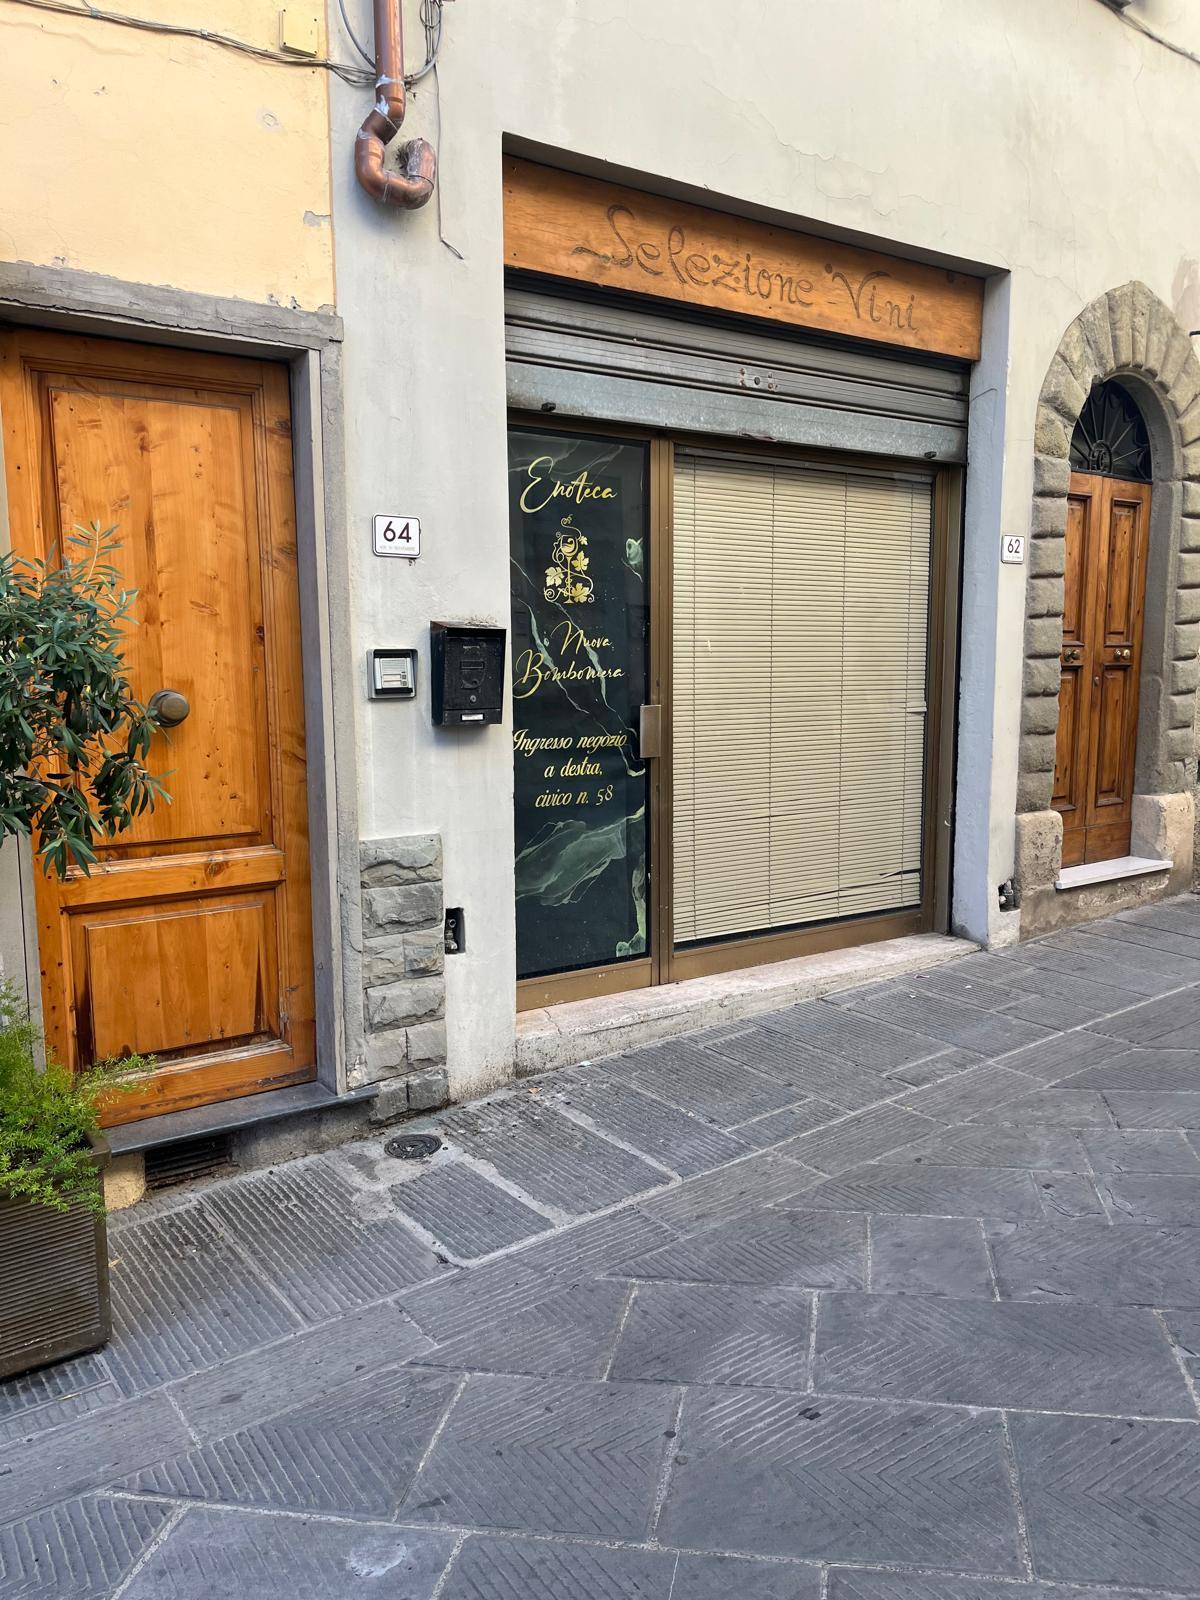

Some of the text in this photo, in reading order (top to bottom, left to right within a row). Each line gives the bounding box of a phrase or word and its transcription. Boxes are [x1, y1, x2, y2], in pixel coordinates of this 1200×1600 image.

[572, 204, 918, 333] Selezione Vini
[520, 456, 617, 514] Enoteca
[383, 520, 412, 543] 64
[1007, 538, 1021, 554] 62
[550, 620, 612, 656] Nuova
[513, 728, 627, 757] Ingresso negozio
[544, 764, 555, 778] a
[535, 784, 614, 808] civico n. 58
